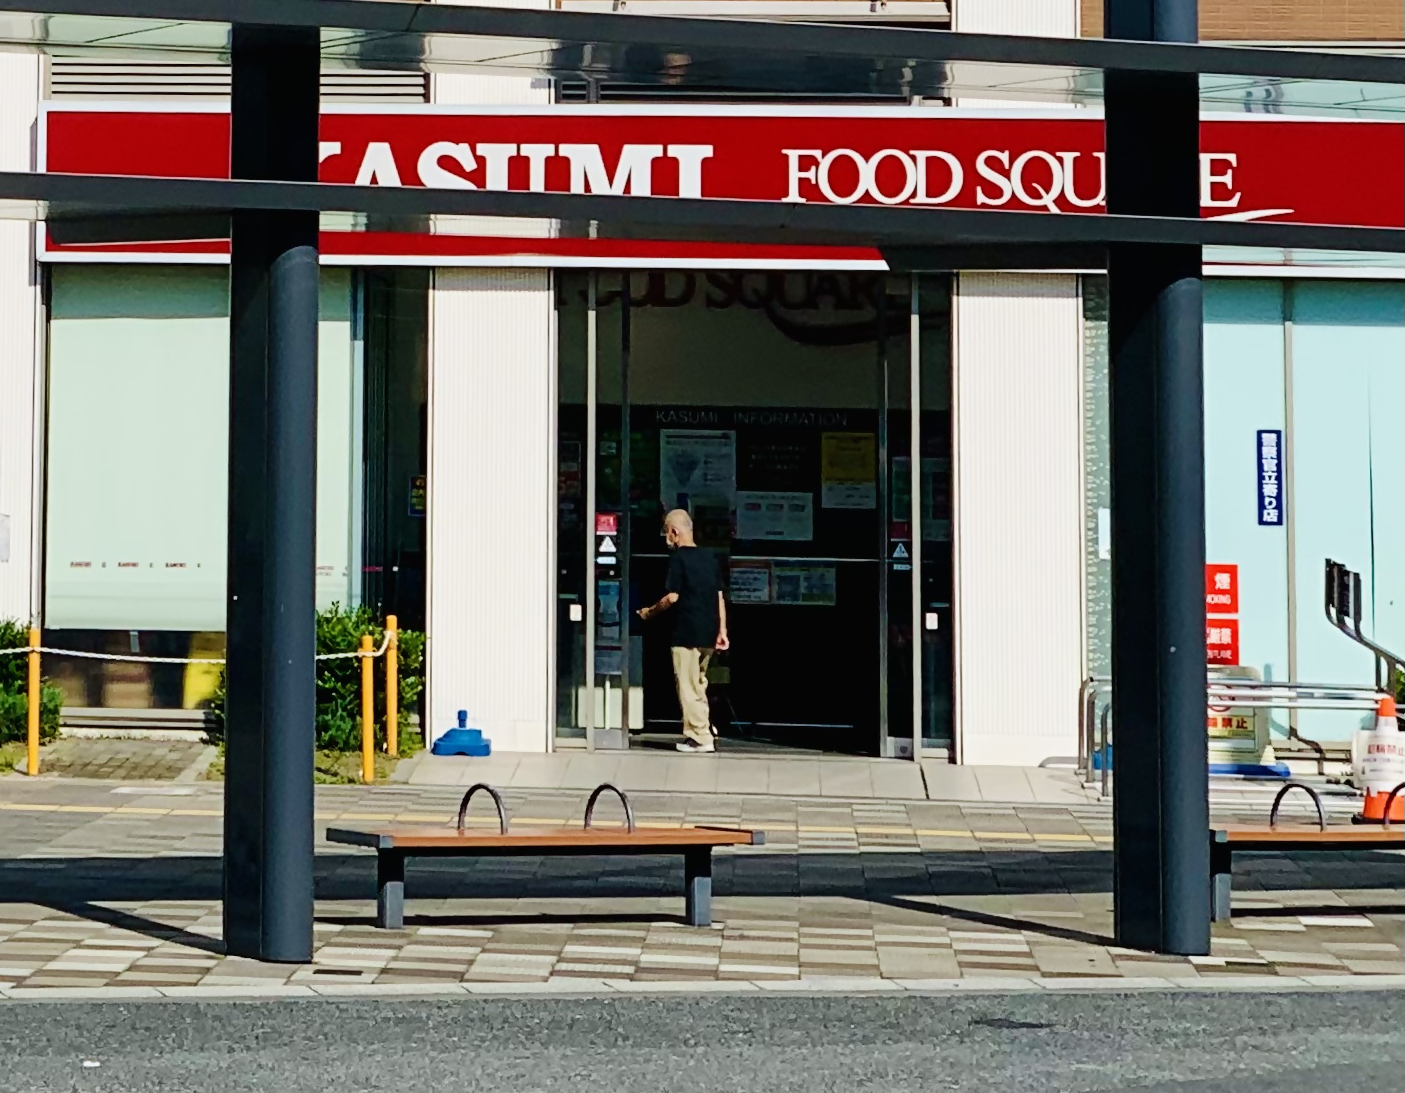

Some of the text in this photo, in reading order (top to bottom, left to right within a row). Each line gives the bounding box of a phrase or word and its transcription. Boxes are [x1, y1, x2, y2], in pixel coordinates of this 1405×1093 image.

[319, 141, 1242, 214] ASUMI FOOD SQUE
[656, 410, 718, 424] KASUMI
